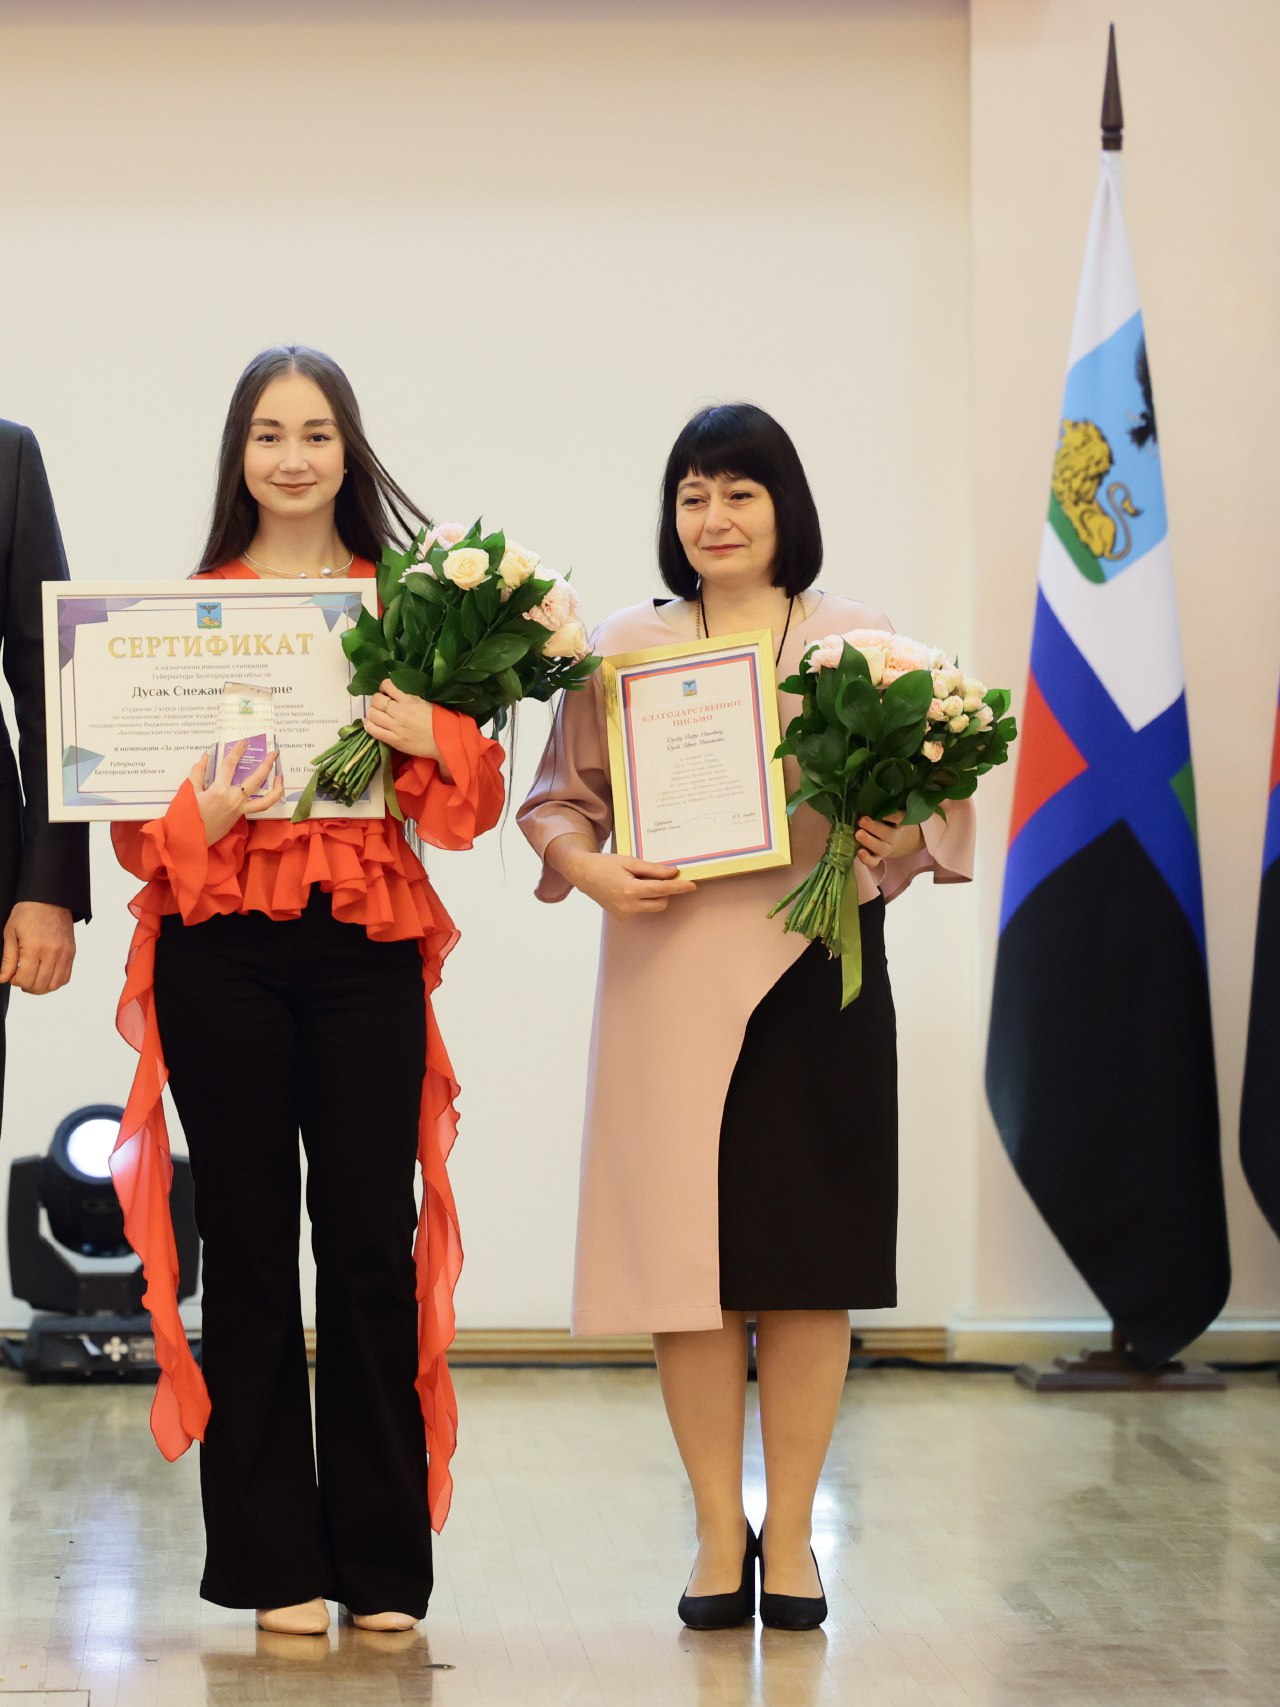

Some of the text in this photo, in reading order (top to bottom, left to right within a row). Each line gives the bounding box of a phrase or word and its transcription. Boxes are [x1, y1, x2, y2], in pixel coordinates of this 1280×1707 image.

[108, 633, 314, 659] СЕРТИФИКАТ
[132, 686, 170, 698] Дусак
[173, 684, 224, 697] Снежан
[642, 699, 743, 722] БЛАГОДАРСТВЕННОЕ
[672, 714, 713, 727] ПИСЬМО
